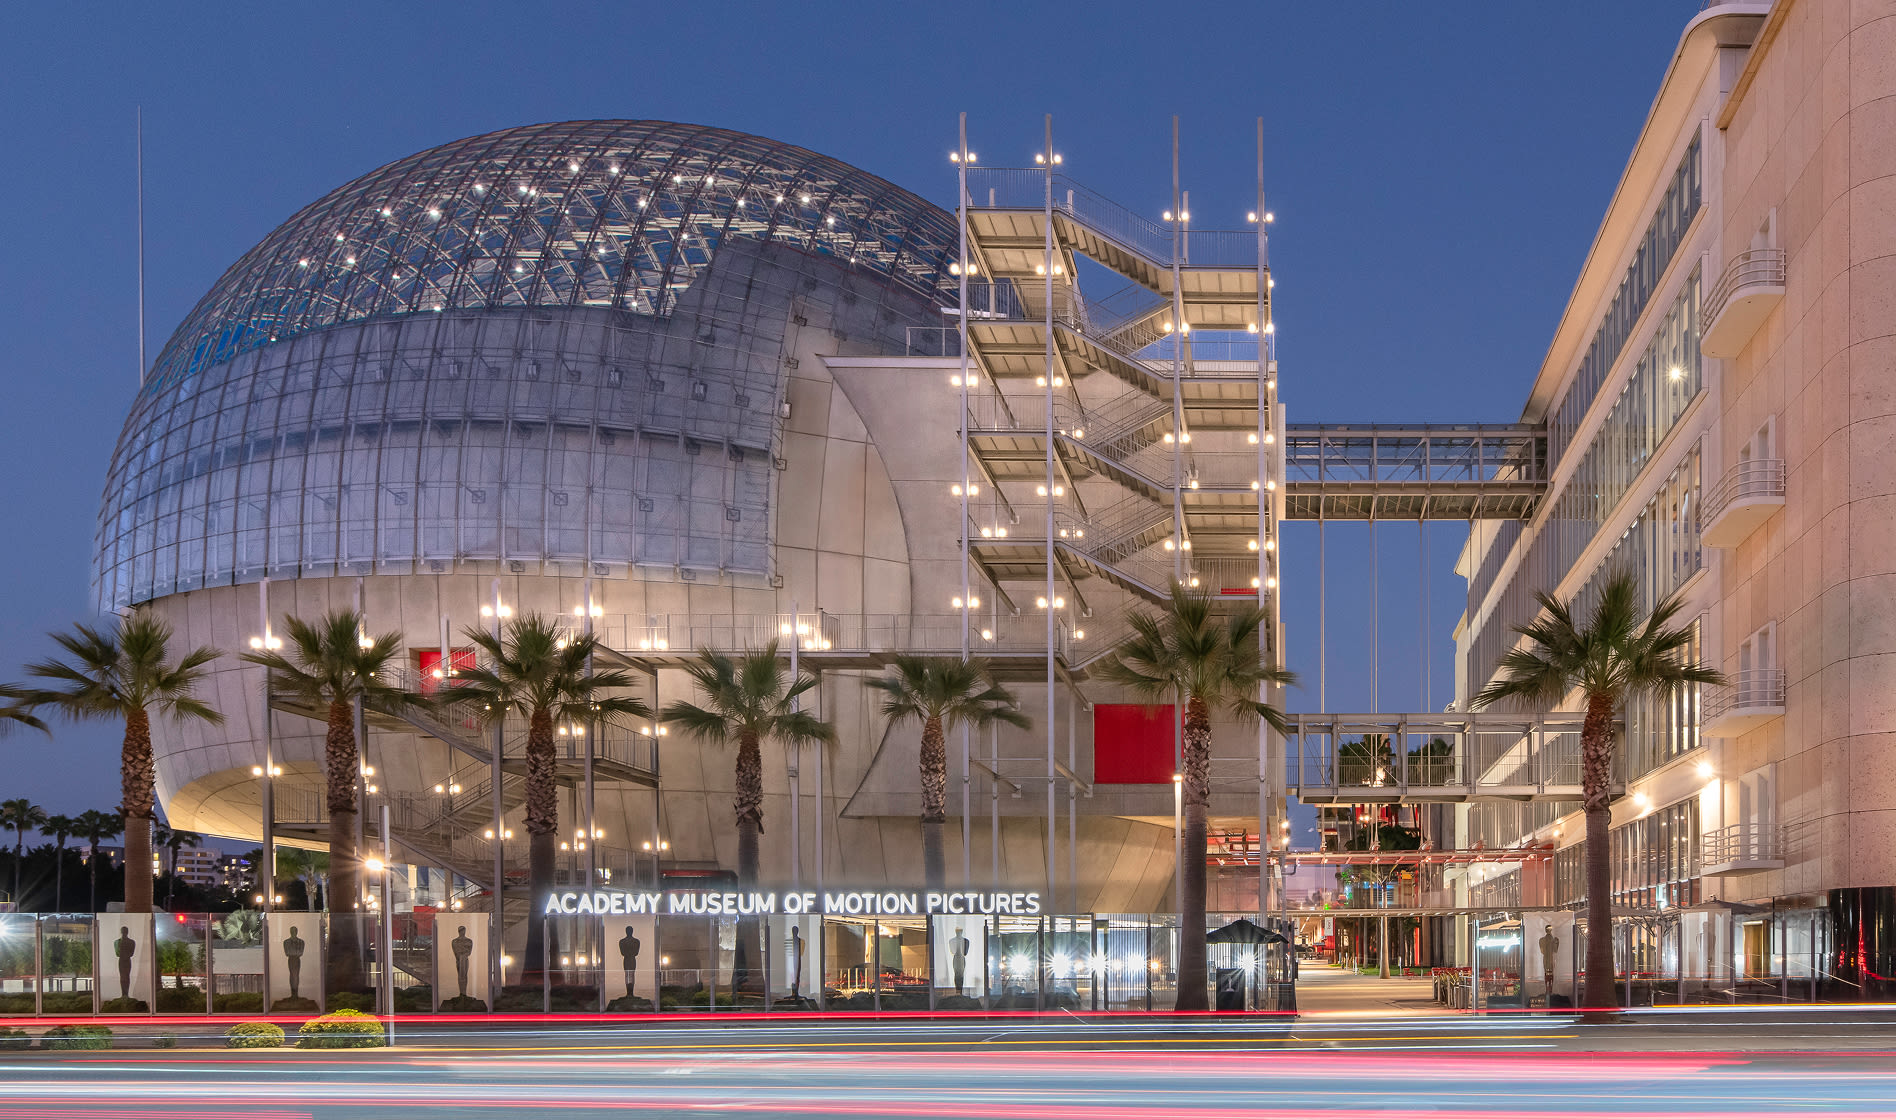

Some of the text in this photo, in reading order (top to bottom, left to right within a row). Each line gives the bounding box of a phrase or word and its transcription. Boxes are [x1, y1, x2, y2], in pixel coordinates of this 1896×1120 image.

[545, 893, 1041, 914] ACADEMY MUSEUM OF MOTION PICTURES
